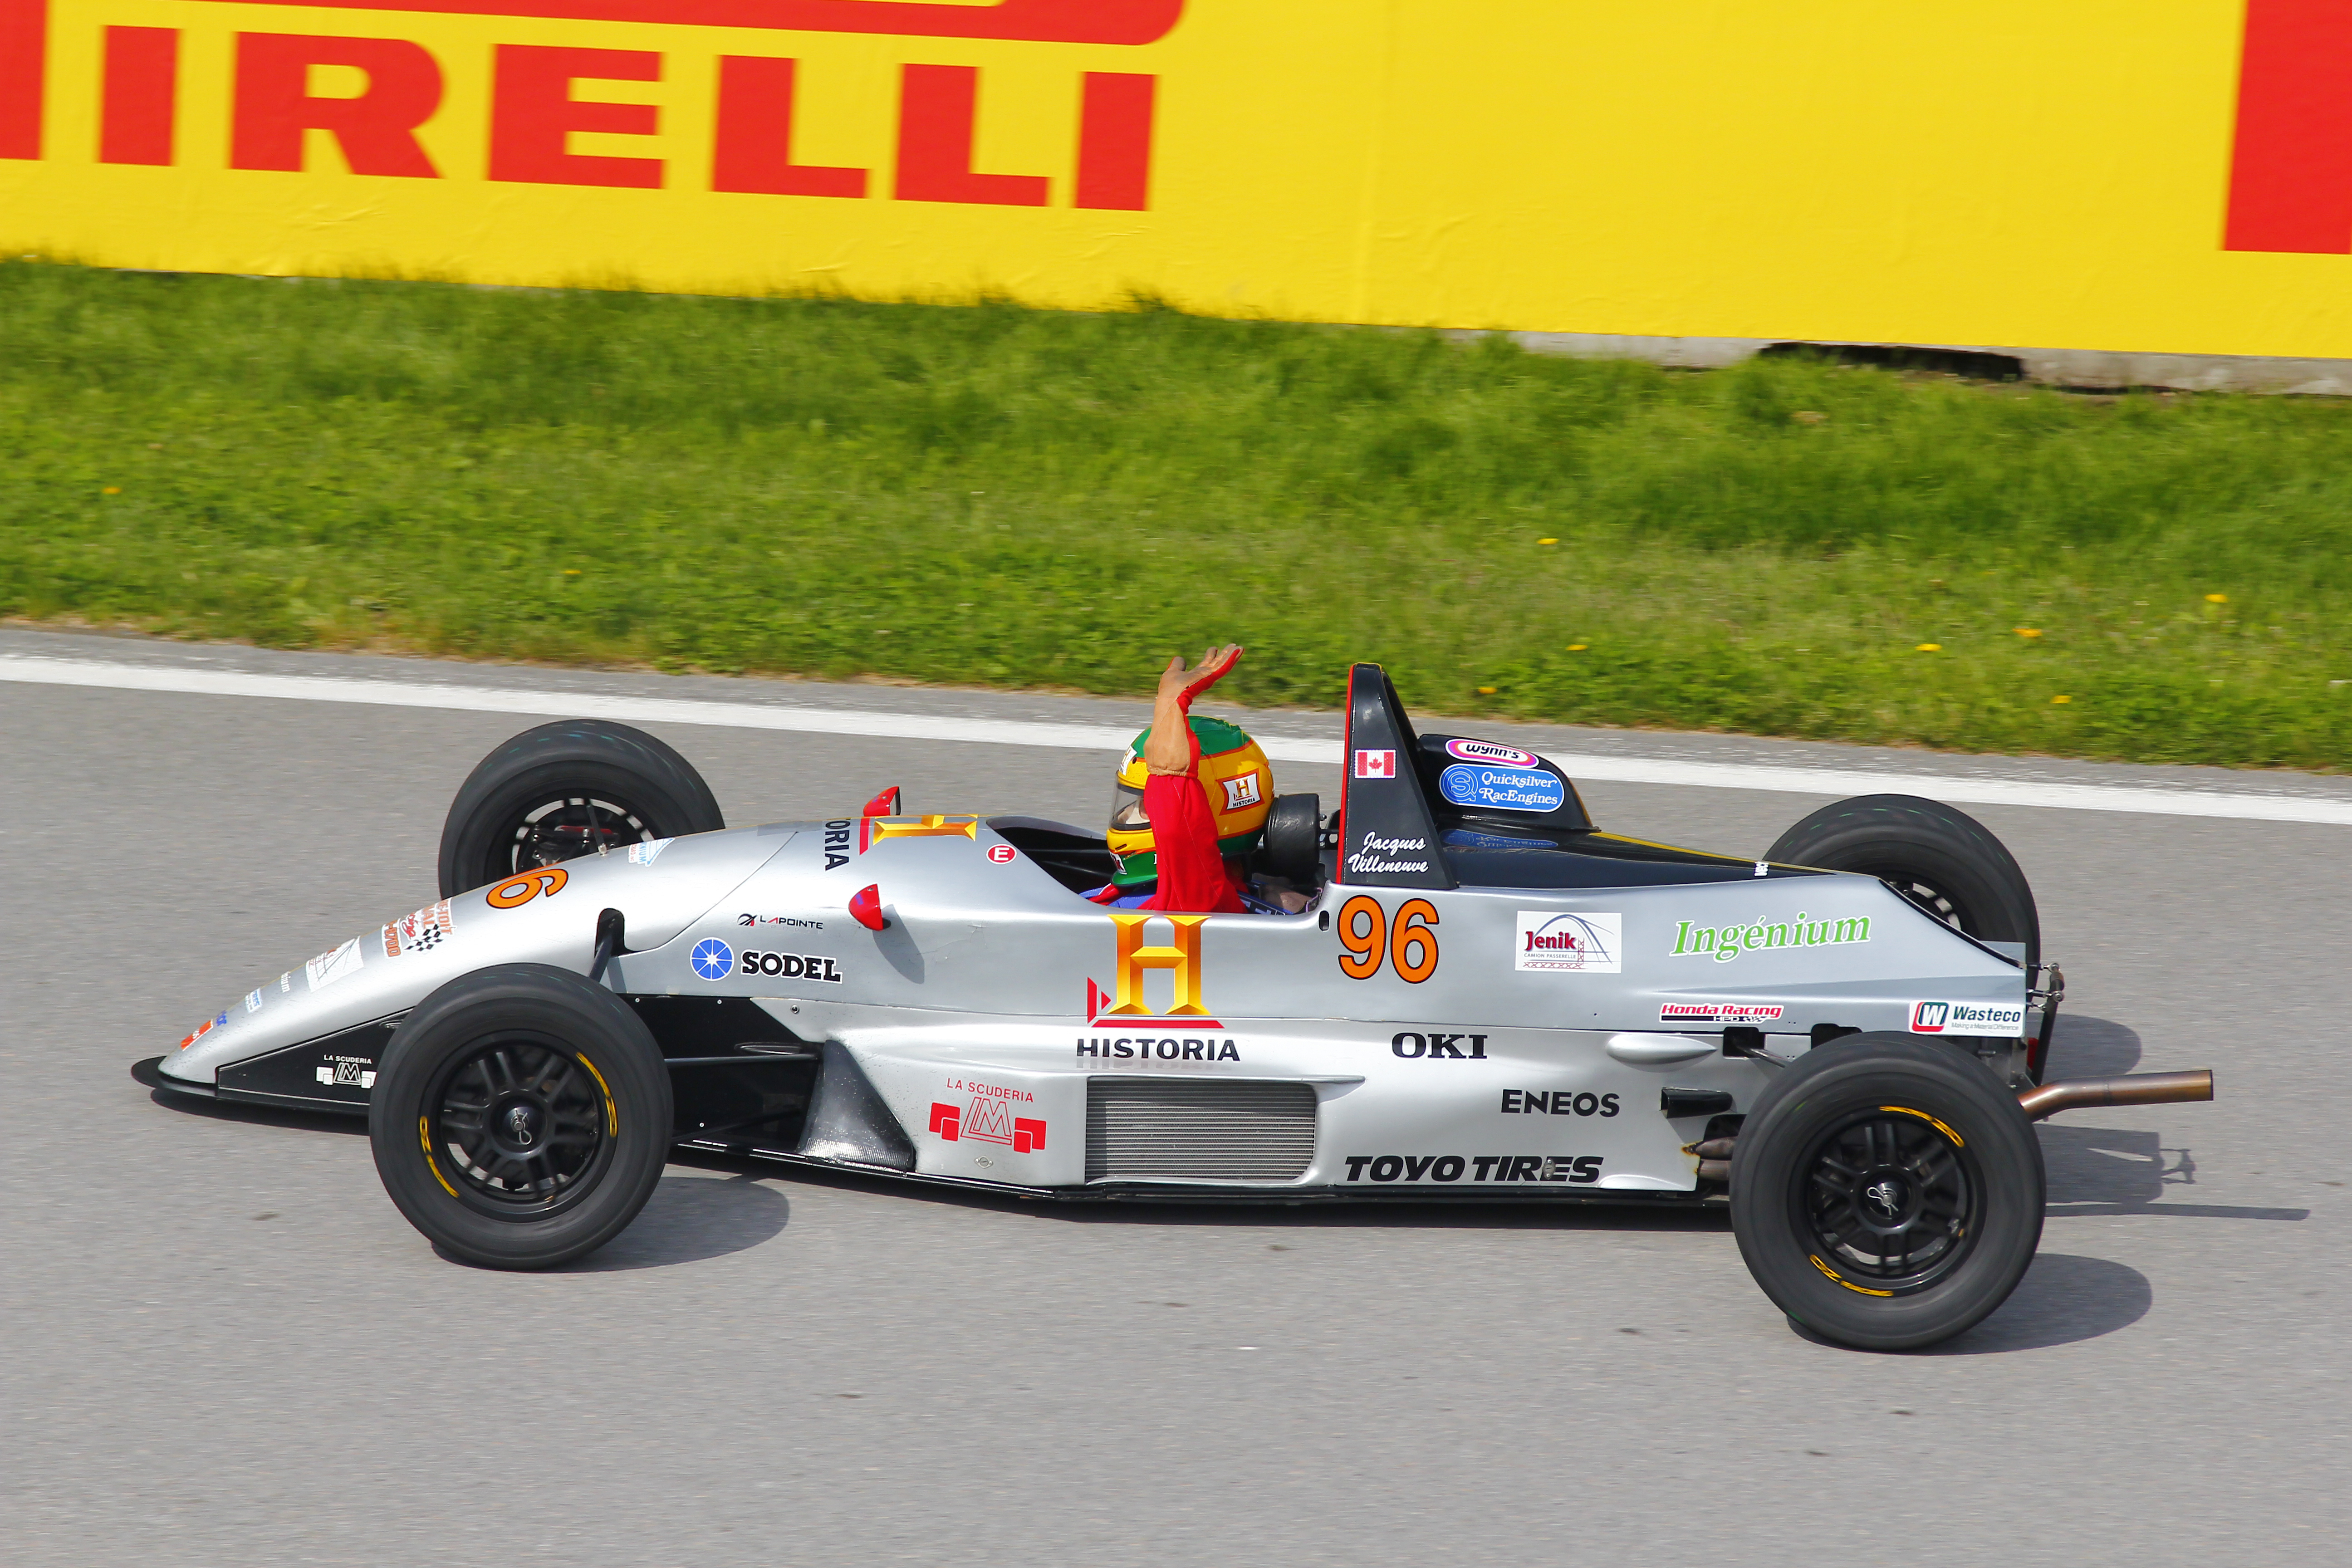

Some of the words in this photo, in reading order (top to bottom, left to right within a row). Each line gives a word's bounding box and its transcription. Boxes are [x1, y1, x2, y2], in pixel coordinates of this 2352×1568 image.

[0, 0, 1189, 211] IRELLI
[1481, 771, 1557, 788] Quicksilver
[1233, 798, 1255, 808] HISTORIA
[1479, 787, 1558, 805] RacEngines
[825, 818, 851, 871] ORIA
[995, 847, 1009, 861] E
[1362, 831, 1426, 857] Jacques
[1348, 853, 1429, 873] Villeneuve
[486, 867, 569, 909] 6
[422, 905, 435, 929] VAL
[438, 899, 453, 935] RE-TOIT
[760, 915, 823, 929] LAPOINTE
[1337, 895, 1440, 984] 96
[1524, 931, 1577, 951] Jenik
[1670, 911, 1871, 962] Ingénium
[741, 951, 842, 983] SODEL
[1107, 915, 1212, 1014] H
[1661, 1004, 1719, 1014] Honda
[1722, 1005, 1782, 1018] Racing
[1953, 1006, 2021, 1022] Wasteco
[1076, 1038, 1241, 1062] HISTORIA
[1392, 1032, 1488, 1059] OKI
[335, 1055, 372, 1064] SCUDERIA
[946, 1078, 963, 1090] LA
[968, 1082, 1034, 1102] SCUDERIA
[1500, 1089, 1620, 1117] ENEOS
[1345, 1155, 1465, 1182] TOYO
[1471, 1155, 1604, 1183] TIRES
